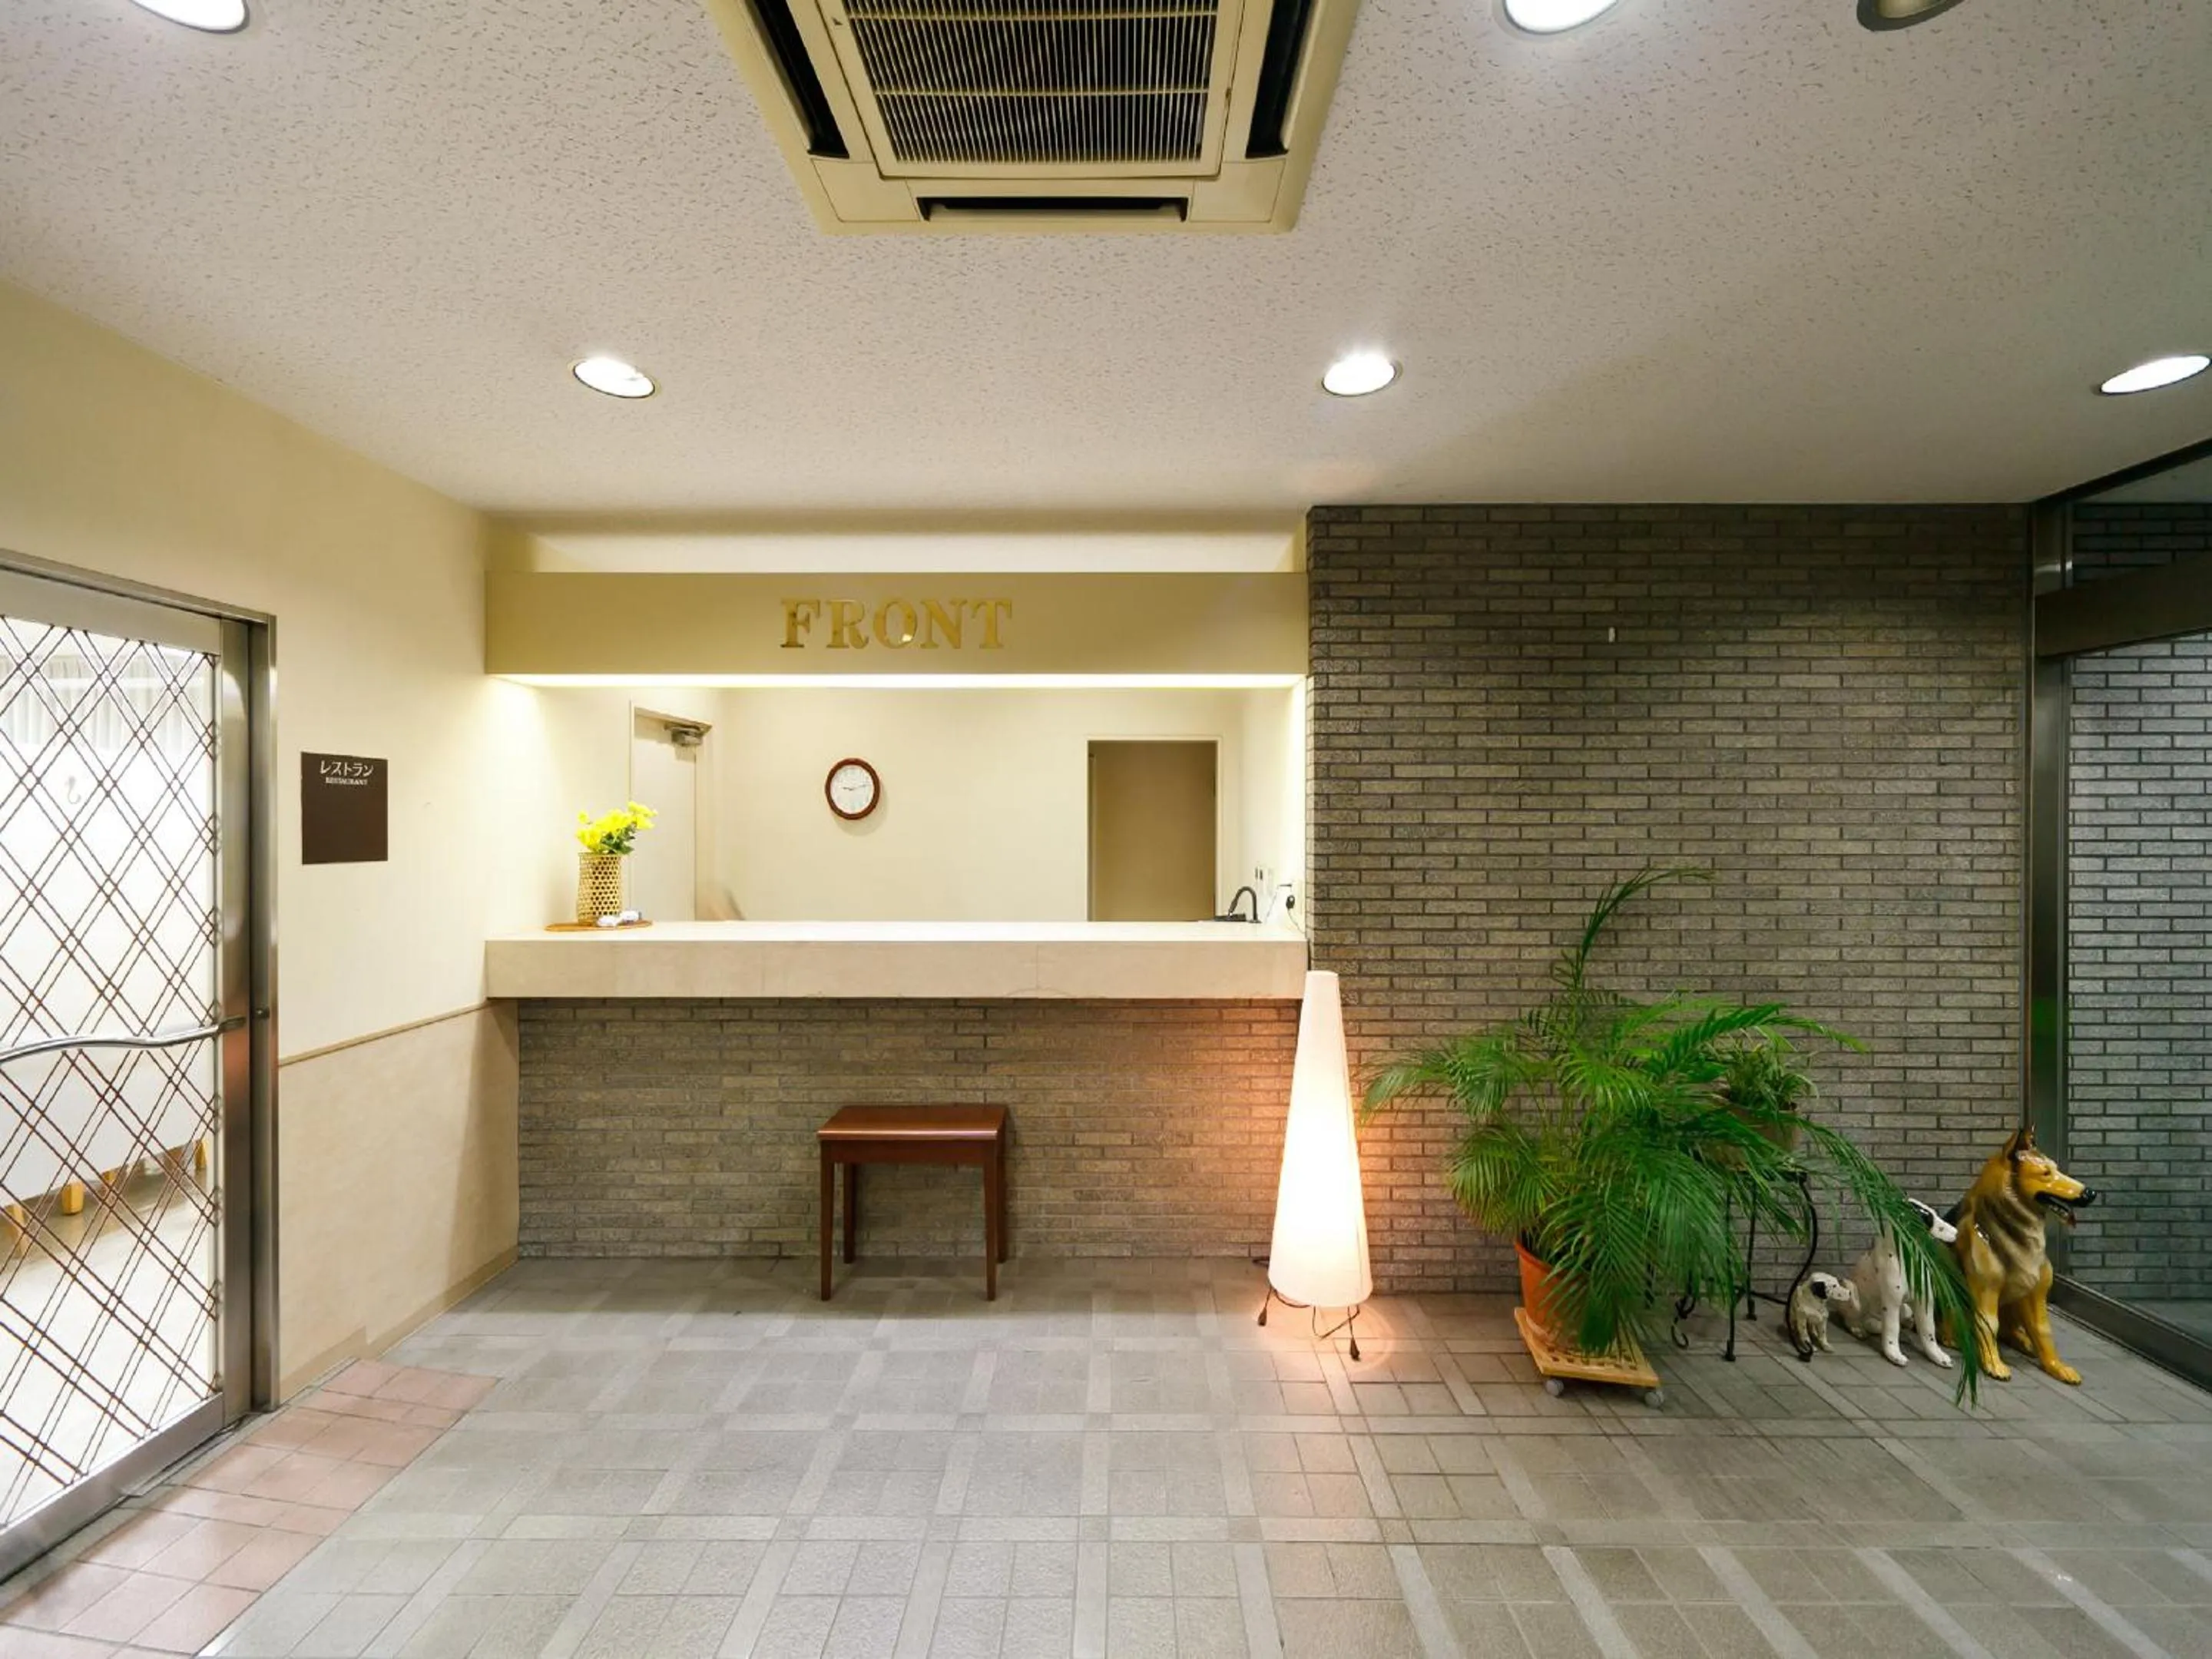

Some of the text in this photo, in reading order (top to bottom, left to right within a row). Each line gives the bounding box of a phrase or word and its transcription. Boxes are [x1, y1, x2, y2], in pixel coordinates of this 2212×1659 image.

[780, 597, 1013, 650] FRONT
[320, 760, 374, 777] レストラン
